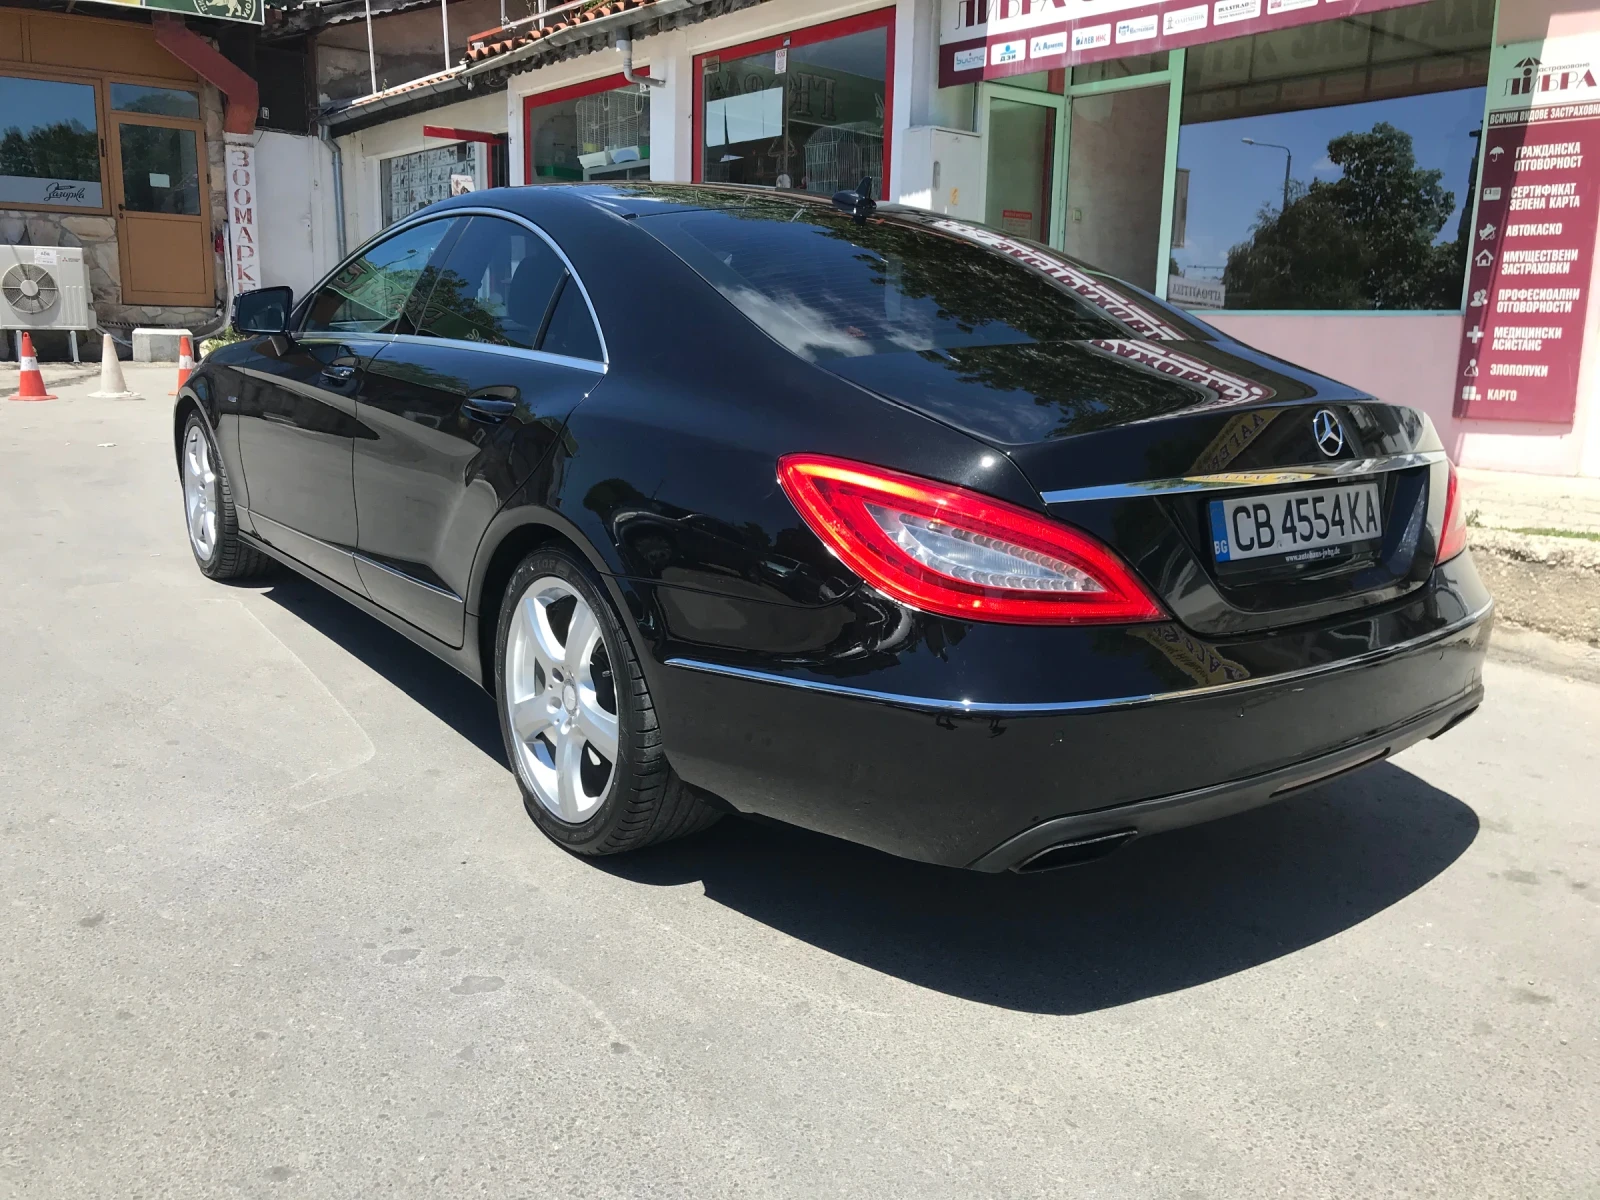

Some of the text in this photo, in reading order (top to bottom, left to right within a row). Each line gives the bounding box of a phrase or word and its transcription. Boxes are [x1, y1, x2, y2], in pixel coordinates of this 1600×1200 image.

[1503, 68, 1597, 97] ЛИБРА
[1489, 111, 1519, 125] ВСИЧКИ
[1519, 107, 1549, 123] ВИДОВЕ
[1515, 142, 1581, 159] ГРАЖДАНСКА
[1514, 155, 1583, 172] ОТГОВОРНОСТ
[1511, 183, 1577, 199] СЕРТИФИКАТ
[1509, 195, 1580, 211] ЗЕЛЕНА КАРТА
[1505, 222, 1563, 237] АВТОКАСКО
[1503, 249, 1578, 263] ИМУЩЕСТВЕНИ
[1501, 262, 1571, 275] ЗАСТРАХОВКИ
[1498, 288, 1581, 301] ПРОФЕСИОАЛНИ
[1496, 301, 1572, 313] ОТГОВОРНОСТИ
[1493, 326, 1562, 340] МЕДИЦИНСКИ
[1491, 339, 1542, 351] АСИСТАНС
[1490, 363, 1549, 377] ЗЛОПОЛУКИ
[1487, 389, 1517, 401] КАРГО
[1232, 490, 1378, 551] CB 4554 KA
[1214, 540, 1228, 555] BG
